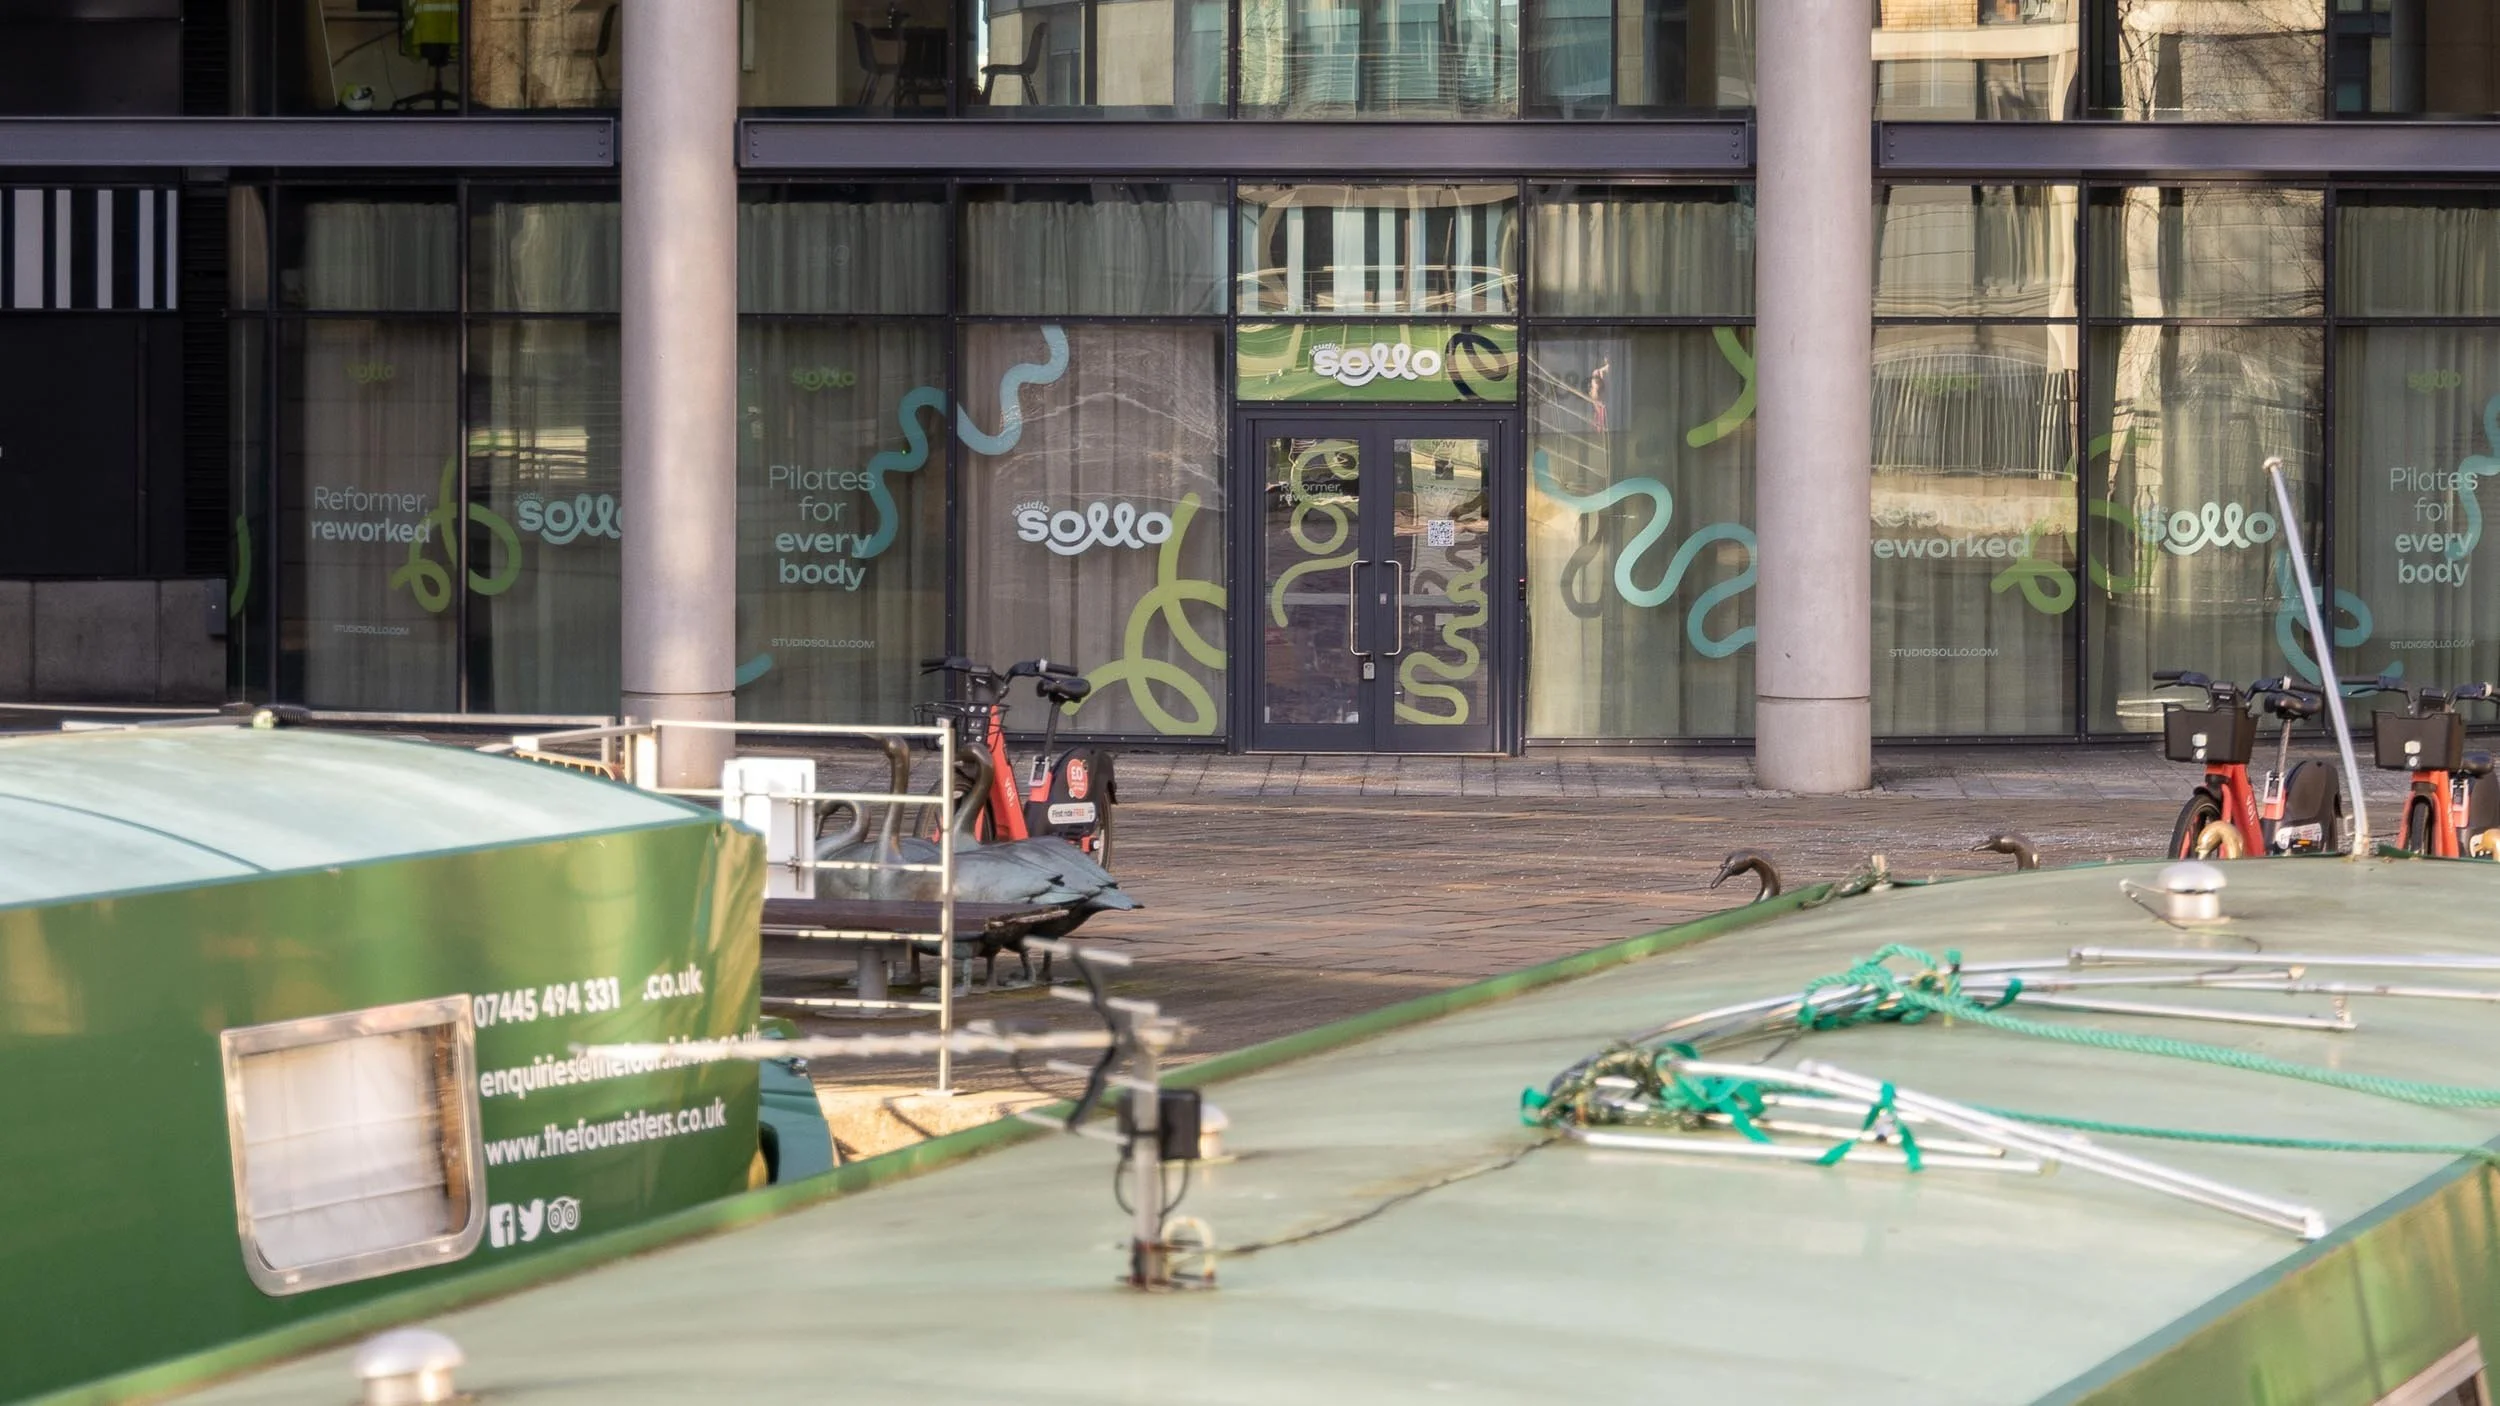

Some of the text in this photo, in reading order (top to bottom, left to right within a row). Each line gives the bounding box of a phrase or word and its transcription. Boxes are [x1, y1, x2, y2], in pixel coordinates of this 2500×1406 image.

[1313, 342, 1442, 387] sollo
[769, 465, 876, 491] Pilates
[1280, 483, 1343, 493] Rormer,
[2390, 467, 2479, 492] Pilates
[314, 487, 430, 515] Reformer,
[799, 496, 847, 522] for
[1012, 500, 1050, 516] studio
[2414, 496, 2453, 522] for
[311, 518, 431, 543] reworked
[518, 494, 622, 545] soll
[1017, 502, 1173, 556] sollo
[2140, 502, 2277, 556] sollo
[775, 530, 873, 558] every
[1871, 533, 2030, 558] eworked
[2395, 531, 2473, 558] every
[779, 559, 866, 592] body
[2399, 559, 2470, 587] body
[771, 638, 875, 650] STUDIOSOLLO.COM
[1889, 647, 1999, 658] STUDIOSOLLO.COM
[2390, 639, 2475, 650] STUDIOSOLLO.COM
[1072, 807, 1085, 817] FREE
[643, 963, 704, 1001] .co.uk
[474, 976, 620, 1028] 07445 494 331
[485, 1097, 727, 1166] www.thefoursisters.co.uk
